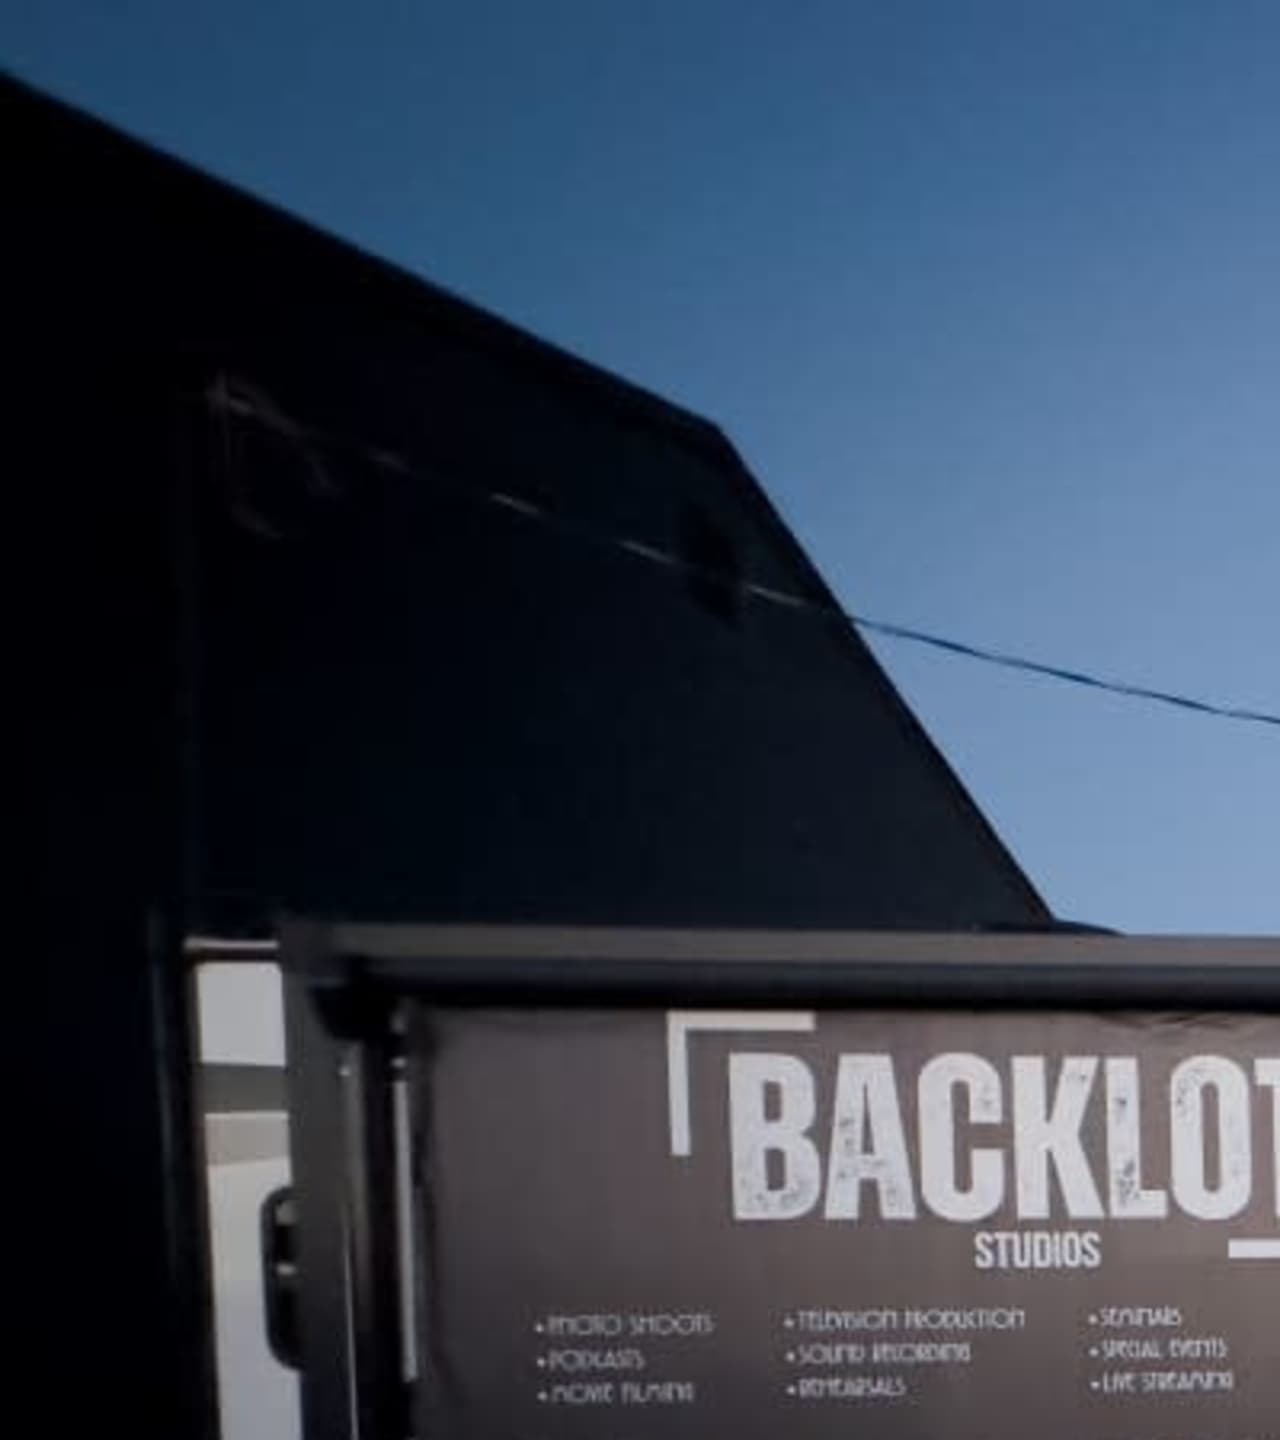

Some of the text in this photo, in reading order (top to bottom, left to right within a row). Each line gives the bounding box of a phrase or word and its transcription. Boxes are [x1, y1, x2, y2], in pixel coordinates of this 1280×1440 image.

[975, 1231, 1101, 1269] STUDIOS
[548, 1313, 715, 1336] PHOTO SHOOTS
[799, 1307, 1026, 1330] TELEVISION PRODUCTION
[1100, 1306, 1181, 1328] SEMINARS
[799, 1343, 865, 1365] SOUND
[1102, 1336, 1227, 1360] SPECIAL EVENTS
[549, 1349, 646, 1372] PODCASTS
[799, 1376, 907, 1398] REHEARSALS
[1103, 1369, 1234, 1392] LIVE STREAMING
[552, 1381, 695, 1404] MOVIE FILMING
